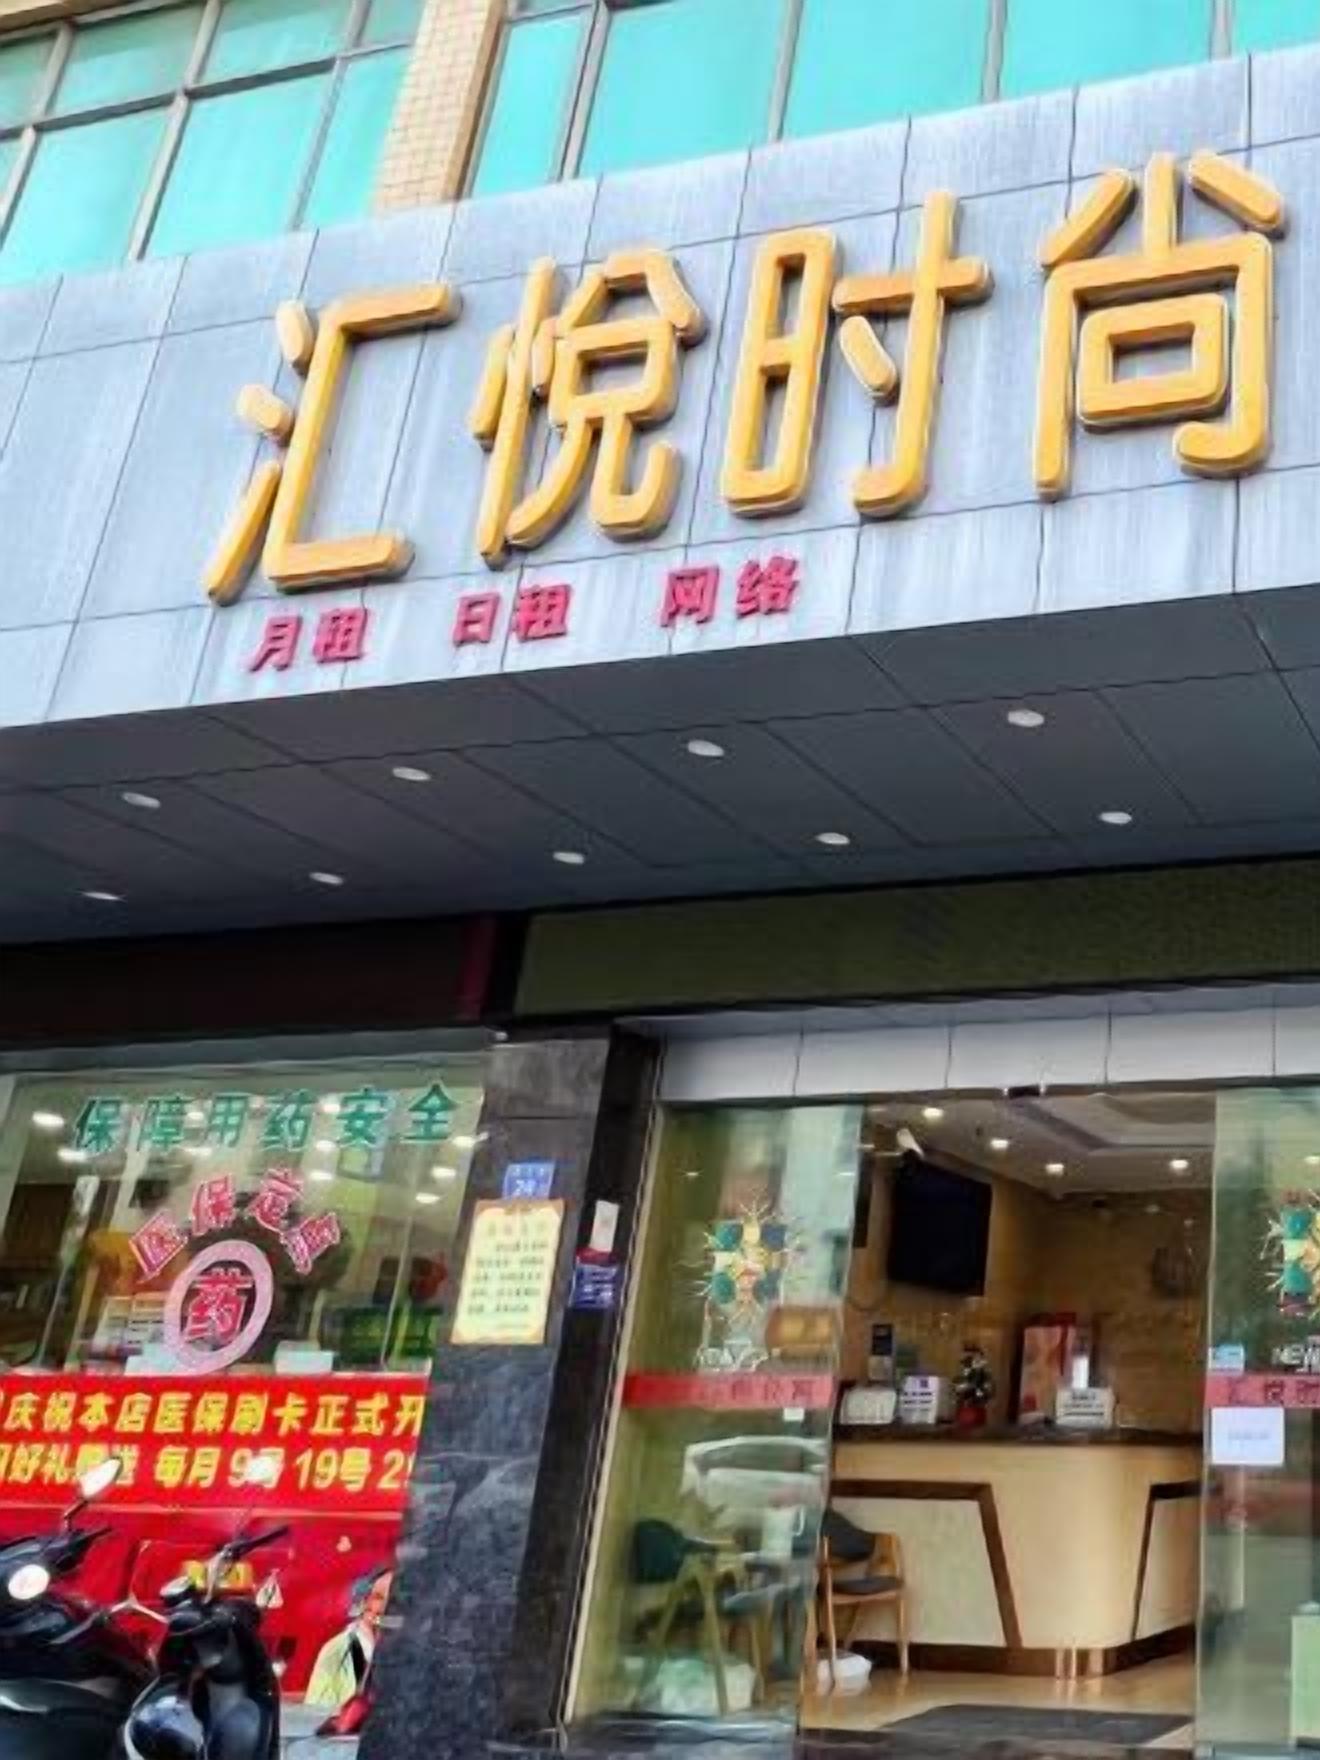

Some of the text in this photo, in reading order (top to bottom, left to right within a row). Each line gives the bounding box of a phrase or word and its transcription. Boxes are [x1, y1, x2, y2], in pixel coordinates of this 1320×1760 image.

[249, 555, 798, 674] 月租 日租 网络
[74, 1083, 460, 1152] 保障用药安全
[184, 1266, 254, 1347] 药
[0, 1391, 427, 1438] 庆祝本店医保刷卡正式开
